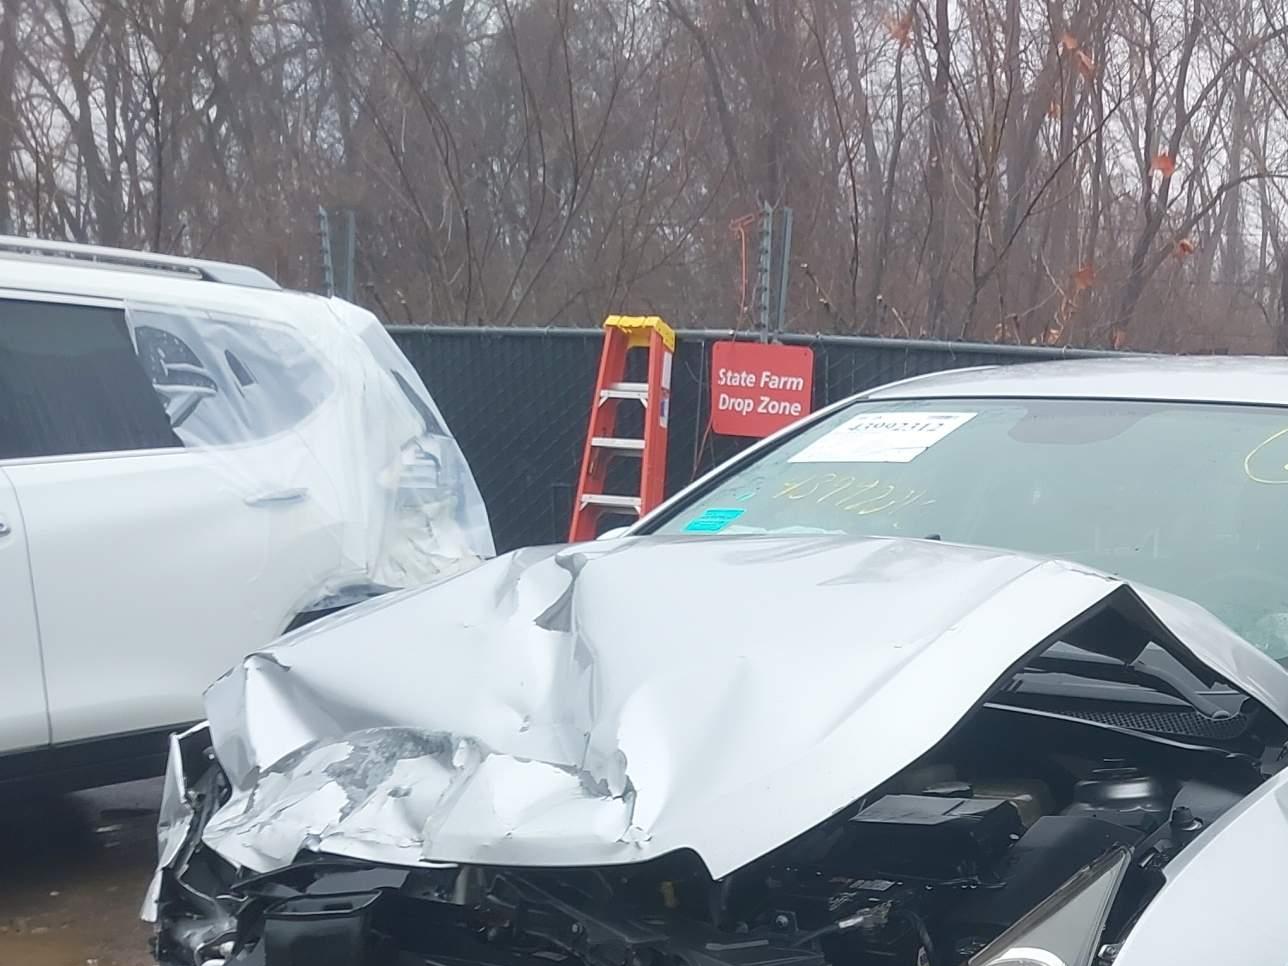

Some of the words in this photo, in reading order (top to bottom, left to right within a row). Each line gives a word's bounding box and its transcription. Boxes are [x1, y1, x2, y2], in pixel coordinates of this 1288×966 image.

[718, 368, 756, 387] State
[760, 371, 804, 391] Farm
[718, 393, 754, 416] Drop
[757, 396, 801, 416] Zone
